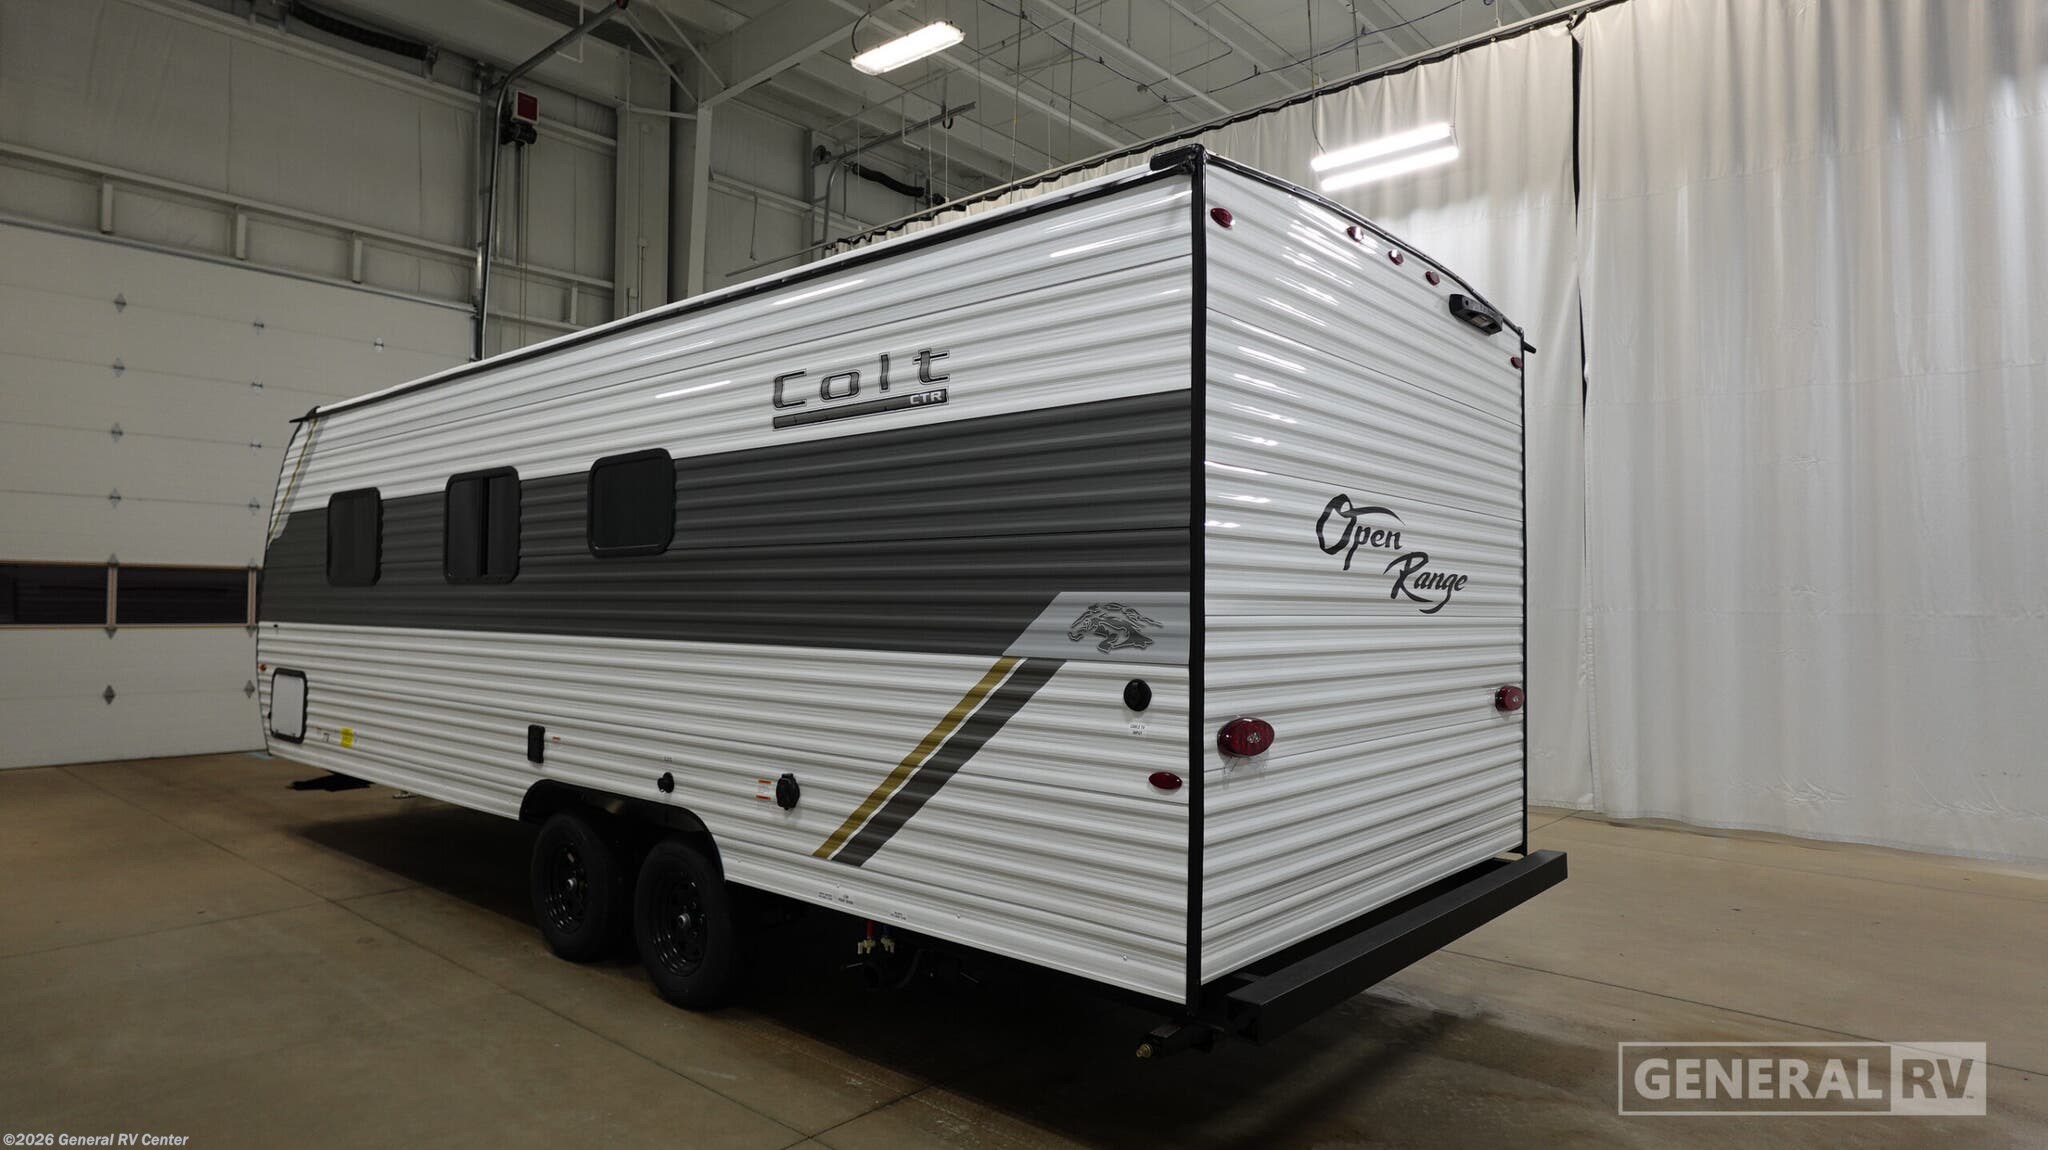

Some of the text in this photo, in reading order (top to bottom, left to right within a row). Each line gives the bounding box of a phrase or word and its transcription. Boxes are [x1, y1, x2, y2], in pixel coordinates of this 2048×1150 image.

[773, 349, 949, 409] Colt
[910, 391, 943, 405] CTR
[1316, 493, 1406, 570] Open
[1383, 551, 1468, 614] Range
